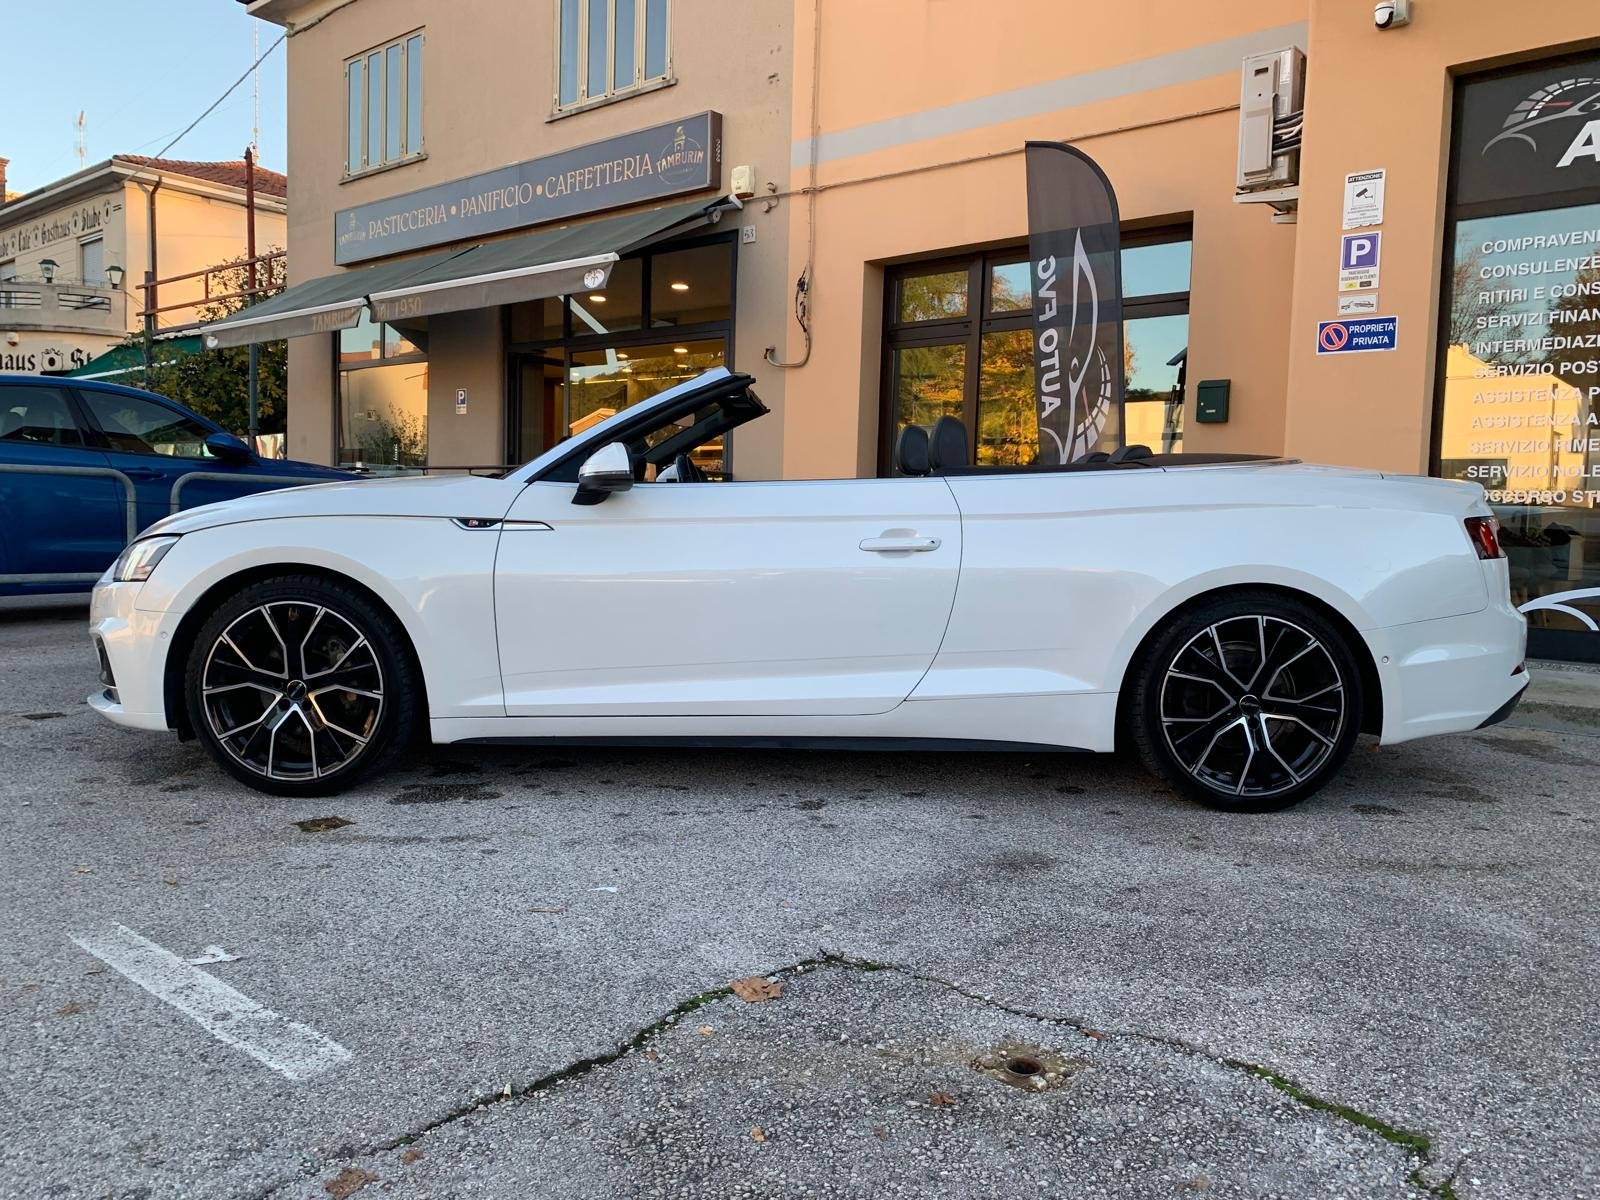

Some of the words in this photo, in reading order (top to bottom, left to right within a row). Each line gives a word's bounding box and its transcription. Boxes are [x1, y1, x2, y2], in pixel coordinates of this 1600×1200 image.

[655, 150, 705, 174] TAMBURIN
[368, 204, 447, 240] PASTICCERIA
[460, 182, 532, 218] PANIFICIO
[545, 153, 653, 199] CAFFETTERIA
[1350, 238, 1372, 266] P
[1479, 287, 1529, 304] RITIRI
[1533, 286, 1546, 300] E
[1476, 311, 1544, 329] SERVIZI
[1353, 335, 1389, 346] PRIVATA
[1474, 362, 1554, 379] SERVIZIO
[1473, 386, 1583, 404] ASSISTENZA
[1472, 412, 1581, 429] ASSISTENZA
[1470, 439, 1550, 455] SERVIZIO
[1467, 464, 1549, 478] SERVIZIO
